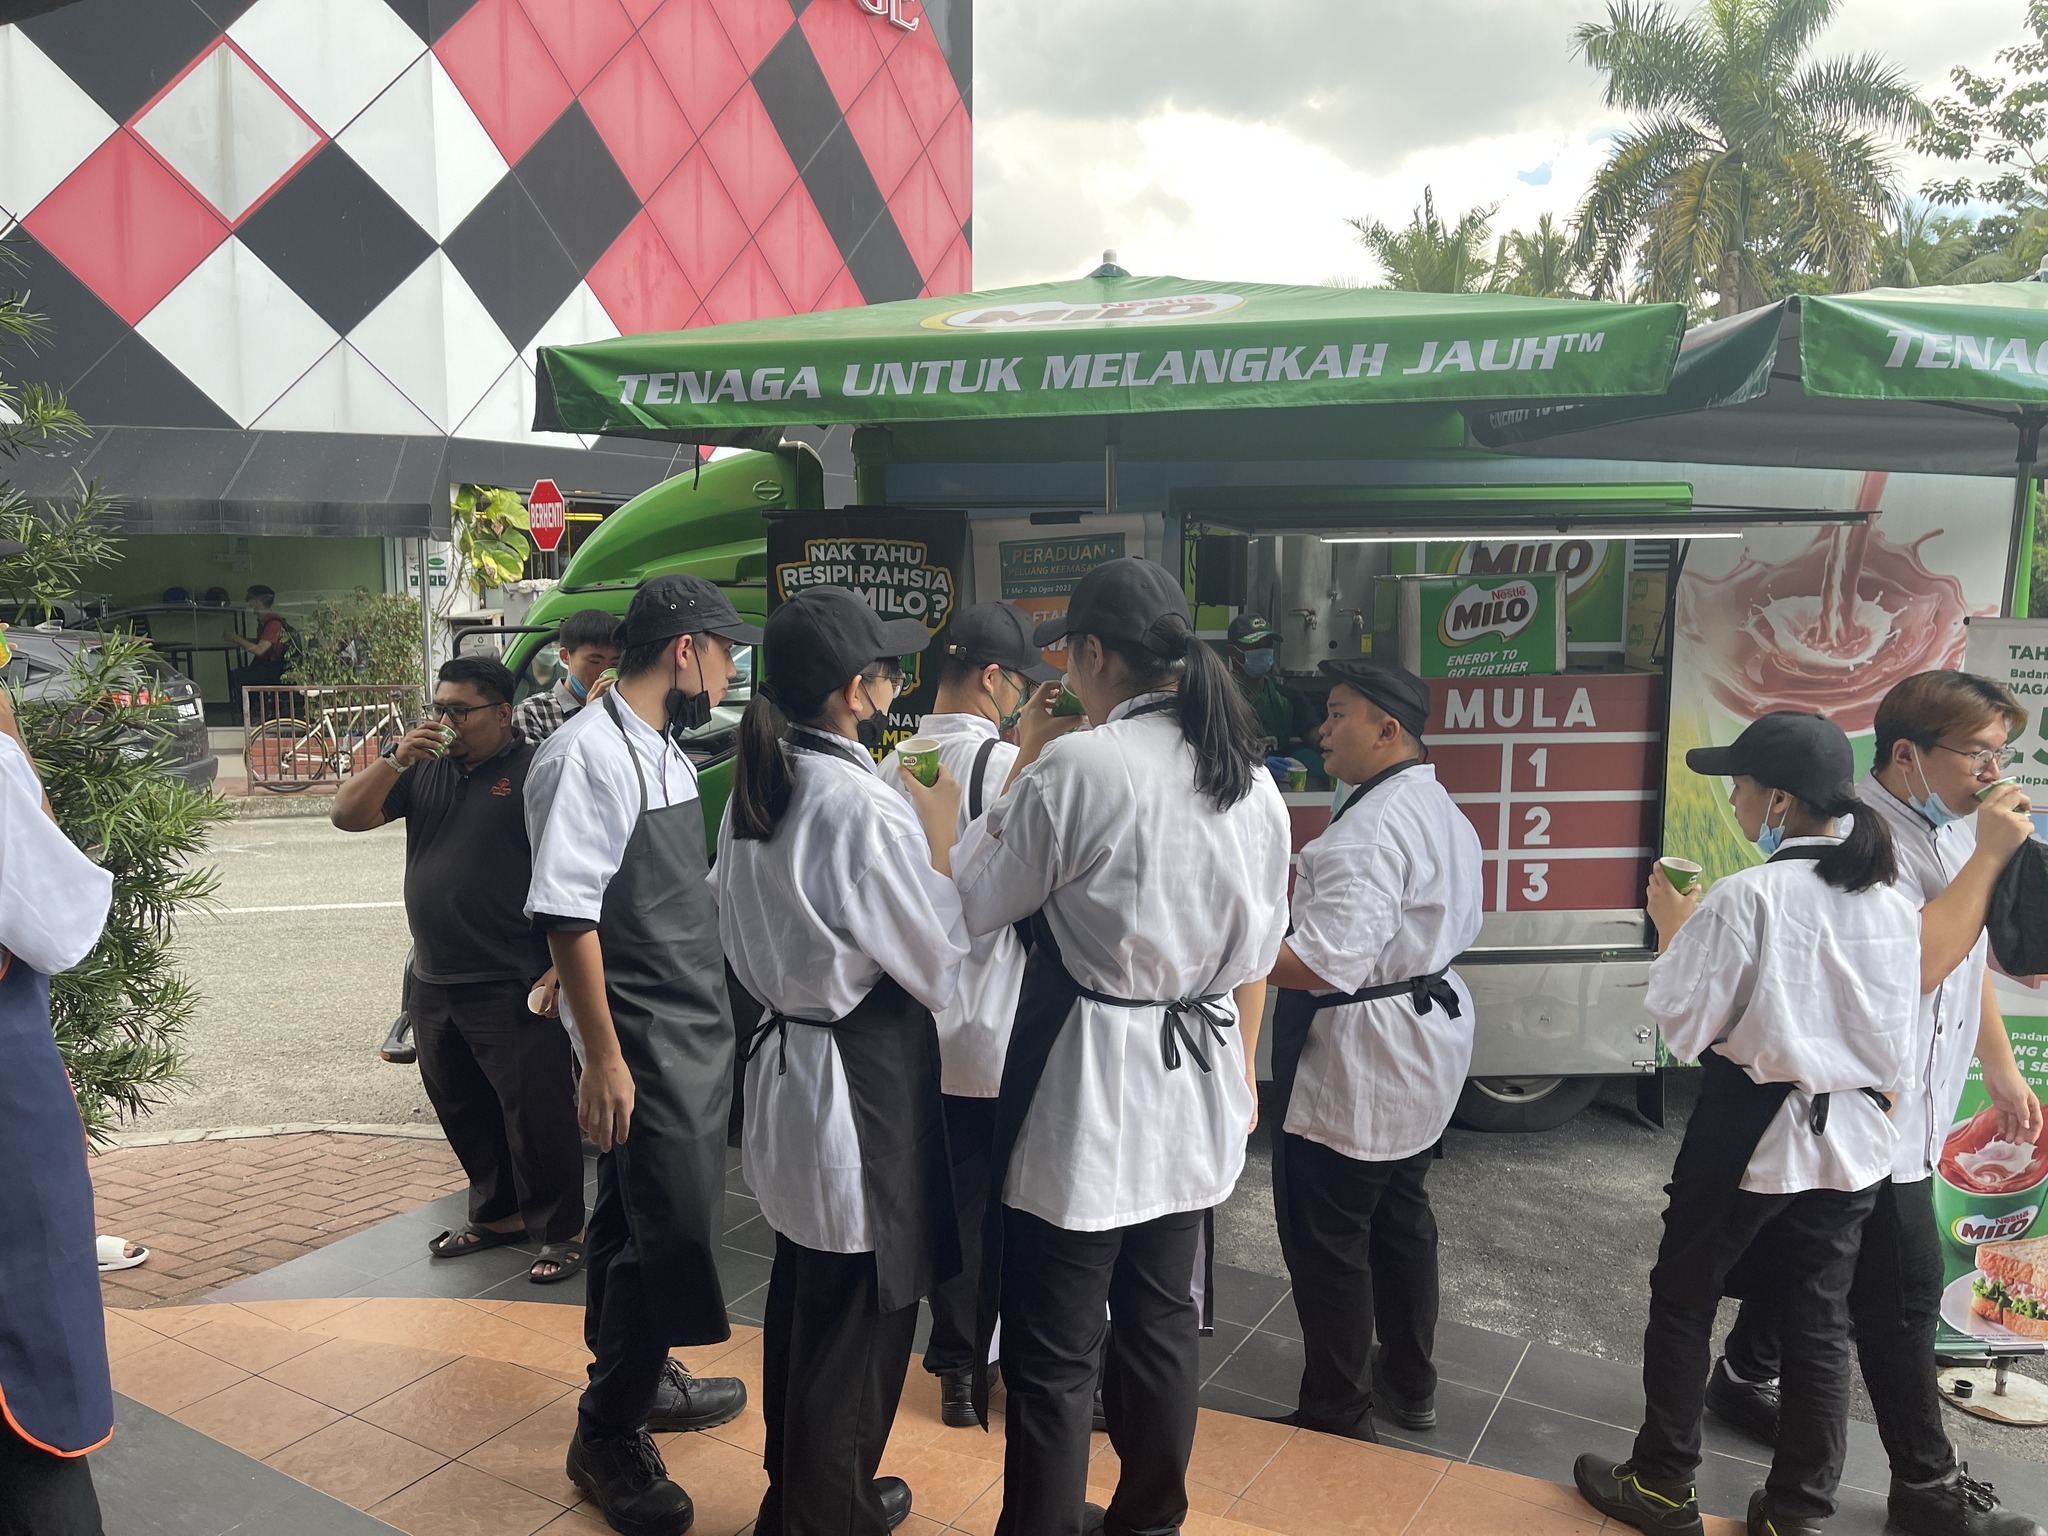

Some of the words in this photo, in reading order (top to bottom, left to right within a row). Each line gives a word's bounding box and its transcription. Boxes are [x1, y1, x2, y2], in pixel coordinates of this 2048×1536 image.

[966, 302, 1217, 324] MILO
[617, 366, 821, 405] TENAGA
[842, 357, 1023, 396] UNTUK
[1040, 343, 1389, 390] MELANGKAH
[530, 502, 562, 529] BERHENTI
[810, 545, 856, 562] NAK
[861, 545, 922, 565] TAHU
[1012, 543, 1107, 565] PERADUAN
[782, 565, 853, 587] RESIPI
[859, 565, 949, 593] RAHSIA
[1008, 566, 1049, 577] PELUANG
[1011, 586, 1023, 595] Mei
[1038, 585, 1054, 594] Ogos
[1055, 584, 1072, 592] 2023
[1452, 598, 1530, 632] MILO
[1447, 652, 1497, 667] ENERGY
[1502, 649, 1518, 661] TO
[1448, 667, 1465, 678] GO
[1469, 661, 1529, 677] FURTHER
[1444, 687, 1597, 729] MULA
[1528, 748, 1548, 788] 1
[1523, 806, 1551, 845] 2
[1521, 862, 1549, 902] 3
[1961, 1218, 2029, 1239] MILO
